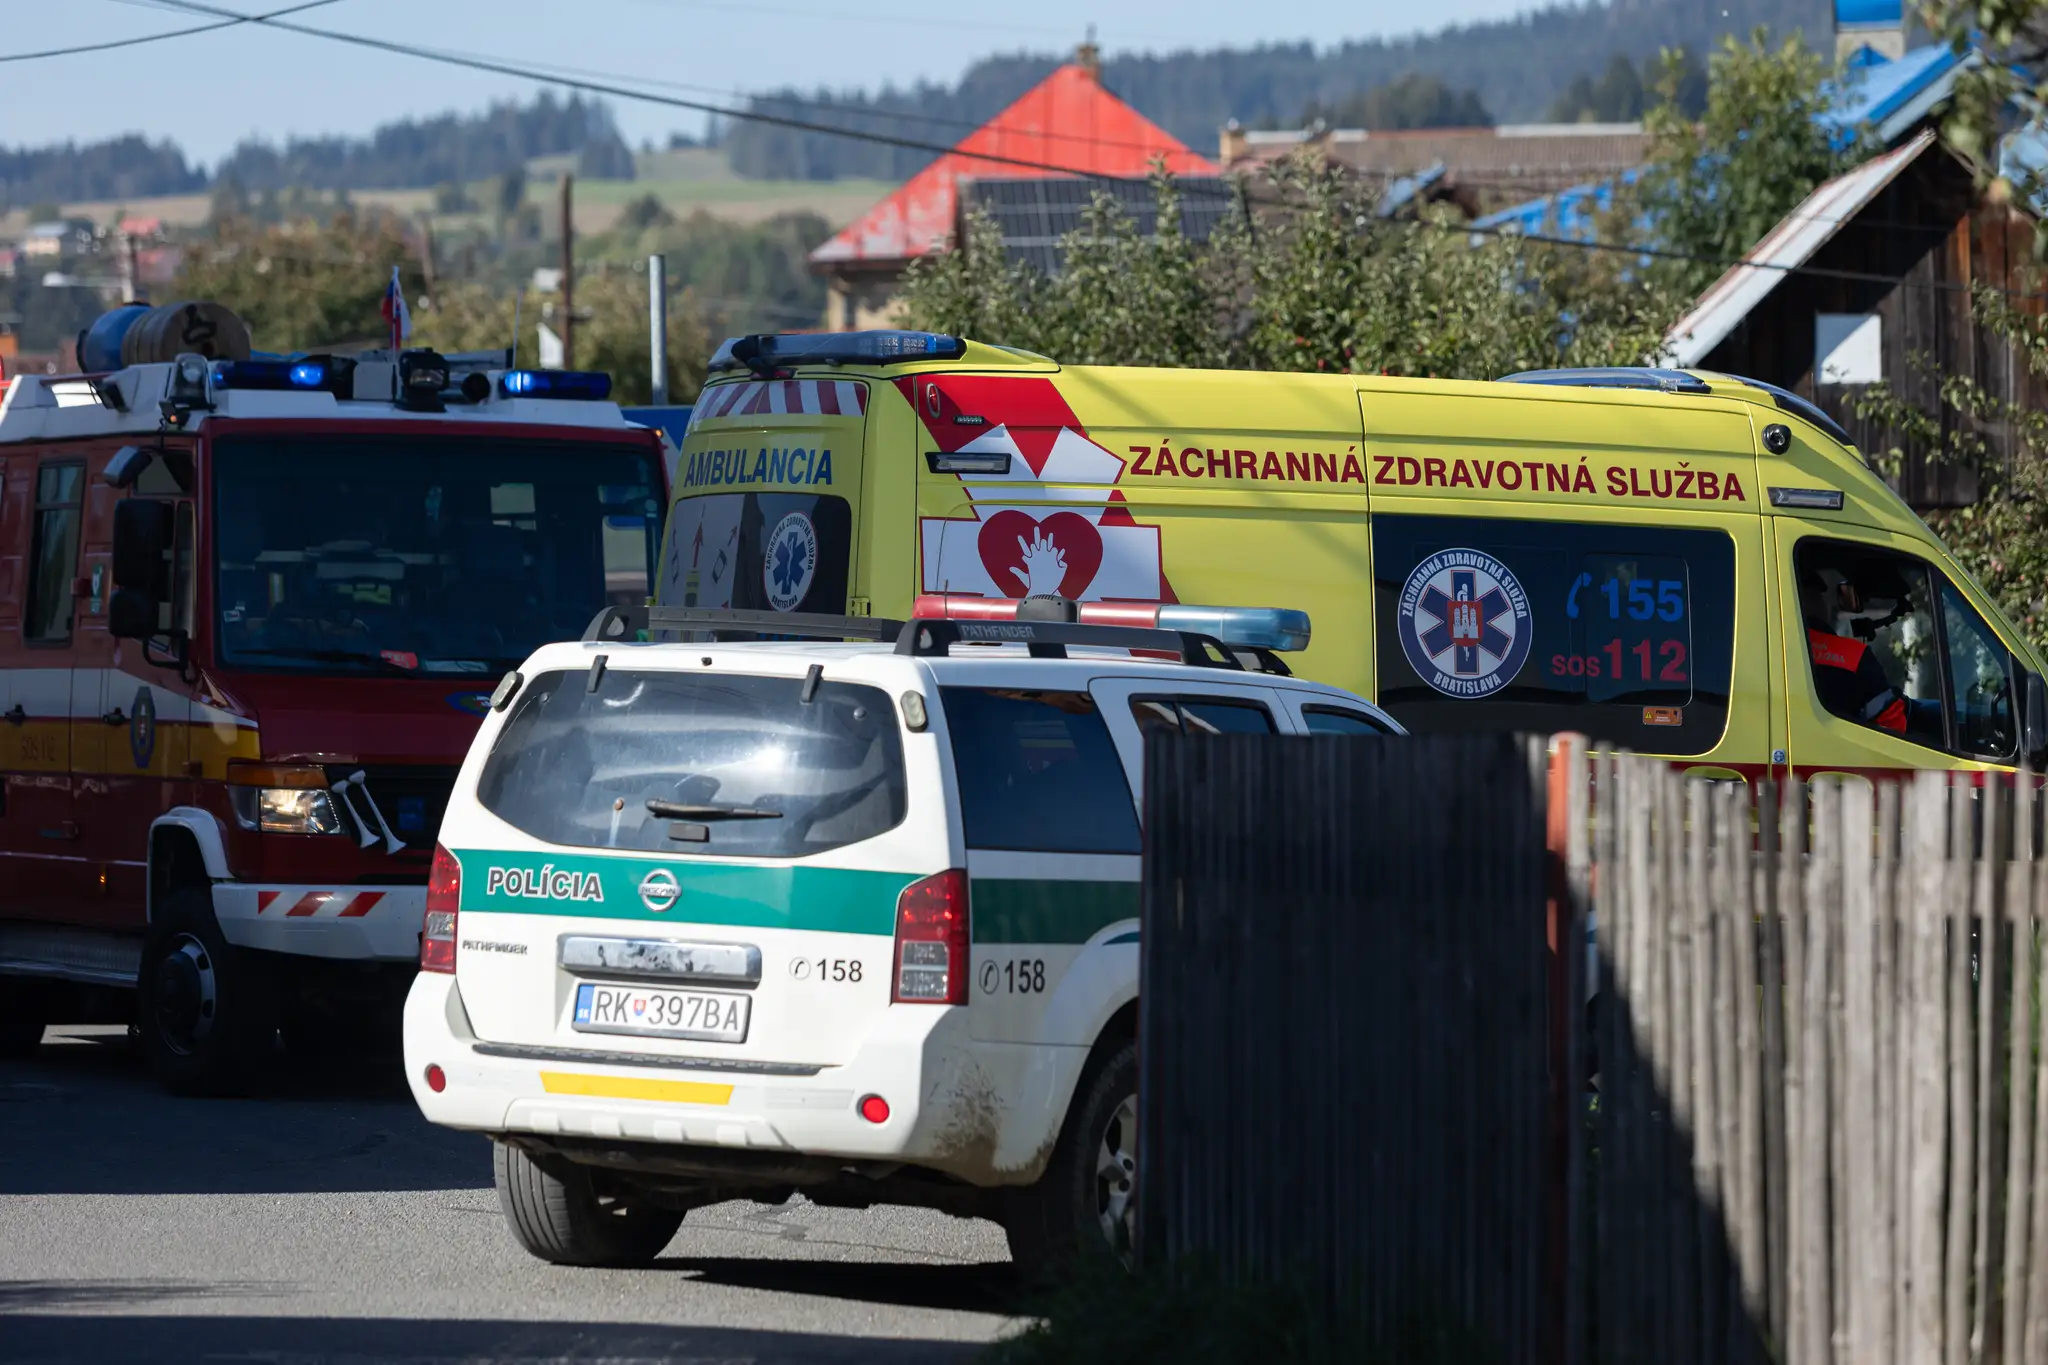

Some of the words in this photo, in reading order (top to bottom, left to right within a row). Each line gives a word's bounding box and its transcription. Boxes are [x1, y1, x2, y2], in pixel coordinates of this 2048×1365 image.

[683, 448, 832, 487] AMBULANCIA
[1129, 438, 1366, 484] ZÁCHRANNÁ
[1372, 455, 1598, 494] ZDRAVOTNÁ
[1605, 461, 1747, 502] SLUŽBA
[1402, 557, 1443, 618] ZÁCHRANNÁ
[1442, 552, 1506, 580] ZDRAVOTNÁ
[1501, 575, 1528, 619] SLUŽBA
[1600, 577, 1684, 622] 155
[961, 624, 1035, 638] PATHFINDER
[1603, 638, 1688, 682] 112
[1433, 671, 1502, 694] BRATISLAVA
[486, 864, 604, 902] POLÍCIA
[816, 958, 863, 983] 158
[1004, 958, 1046, 994] 158
